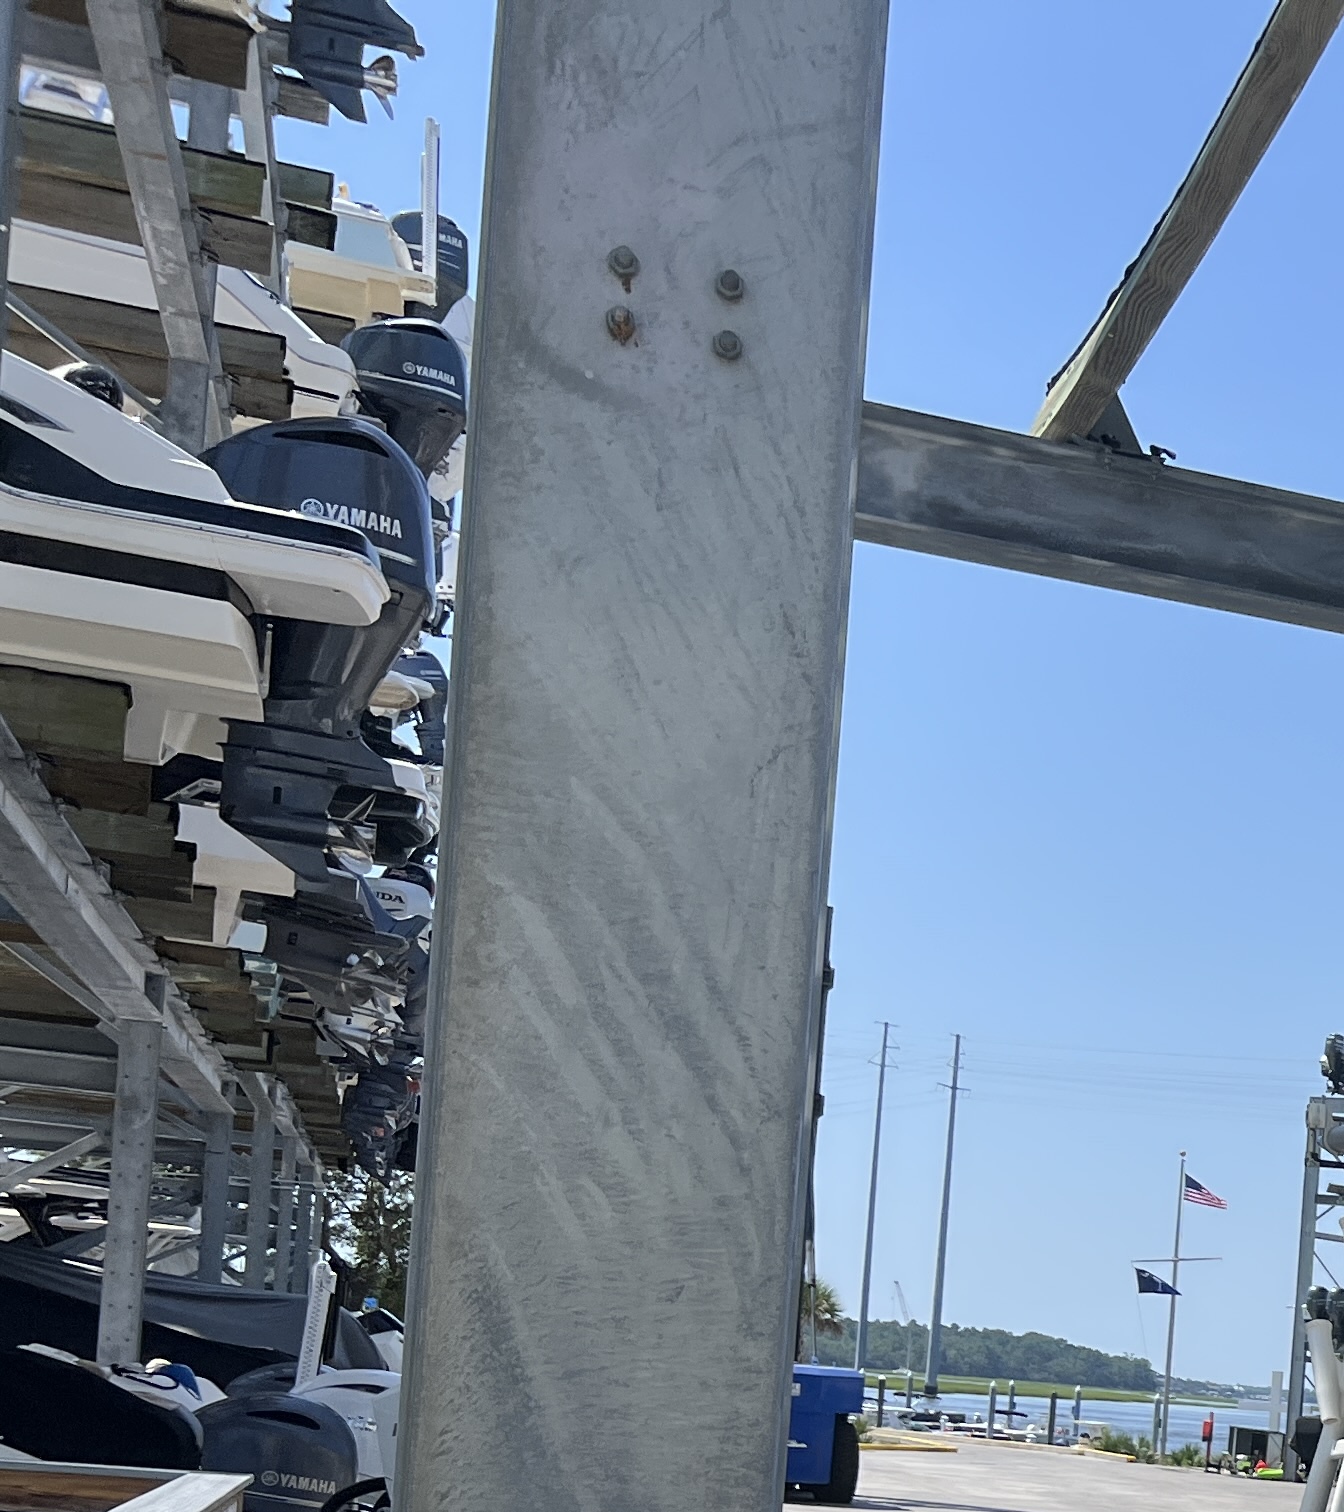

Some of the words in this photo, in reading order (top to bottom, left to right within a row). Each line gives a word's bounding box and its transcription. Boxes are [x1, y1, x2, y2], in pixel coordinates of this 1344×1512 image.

[438, 232, 463, 249] MAHA
[415, 365, 457, 387] YAMAHA
[325, 502, 402, 539] YAMAHA
[281, 1473, 336, 1494] YAMAHA
